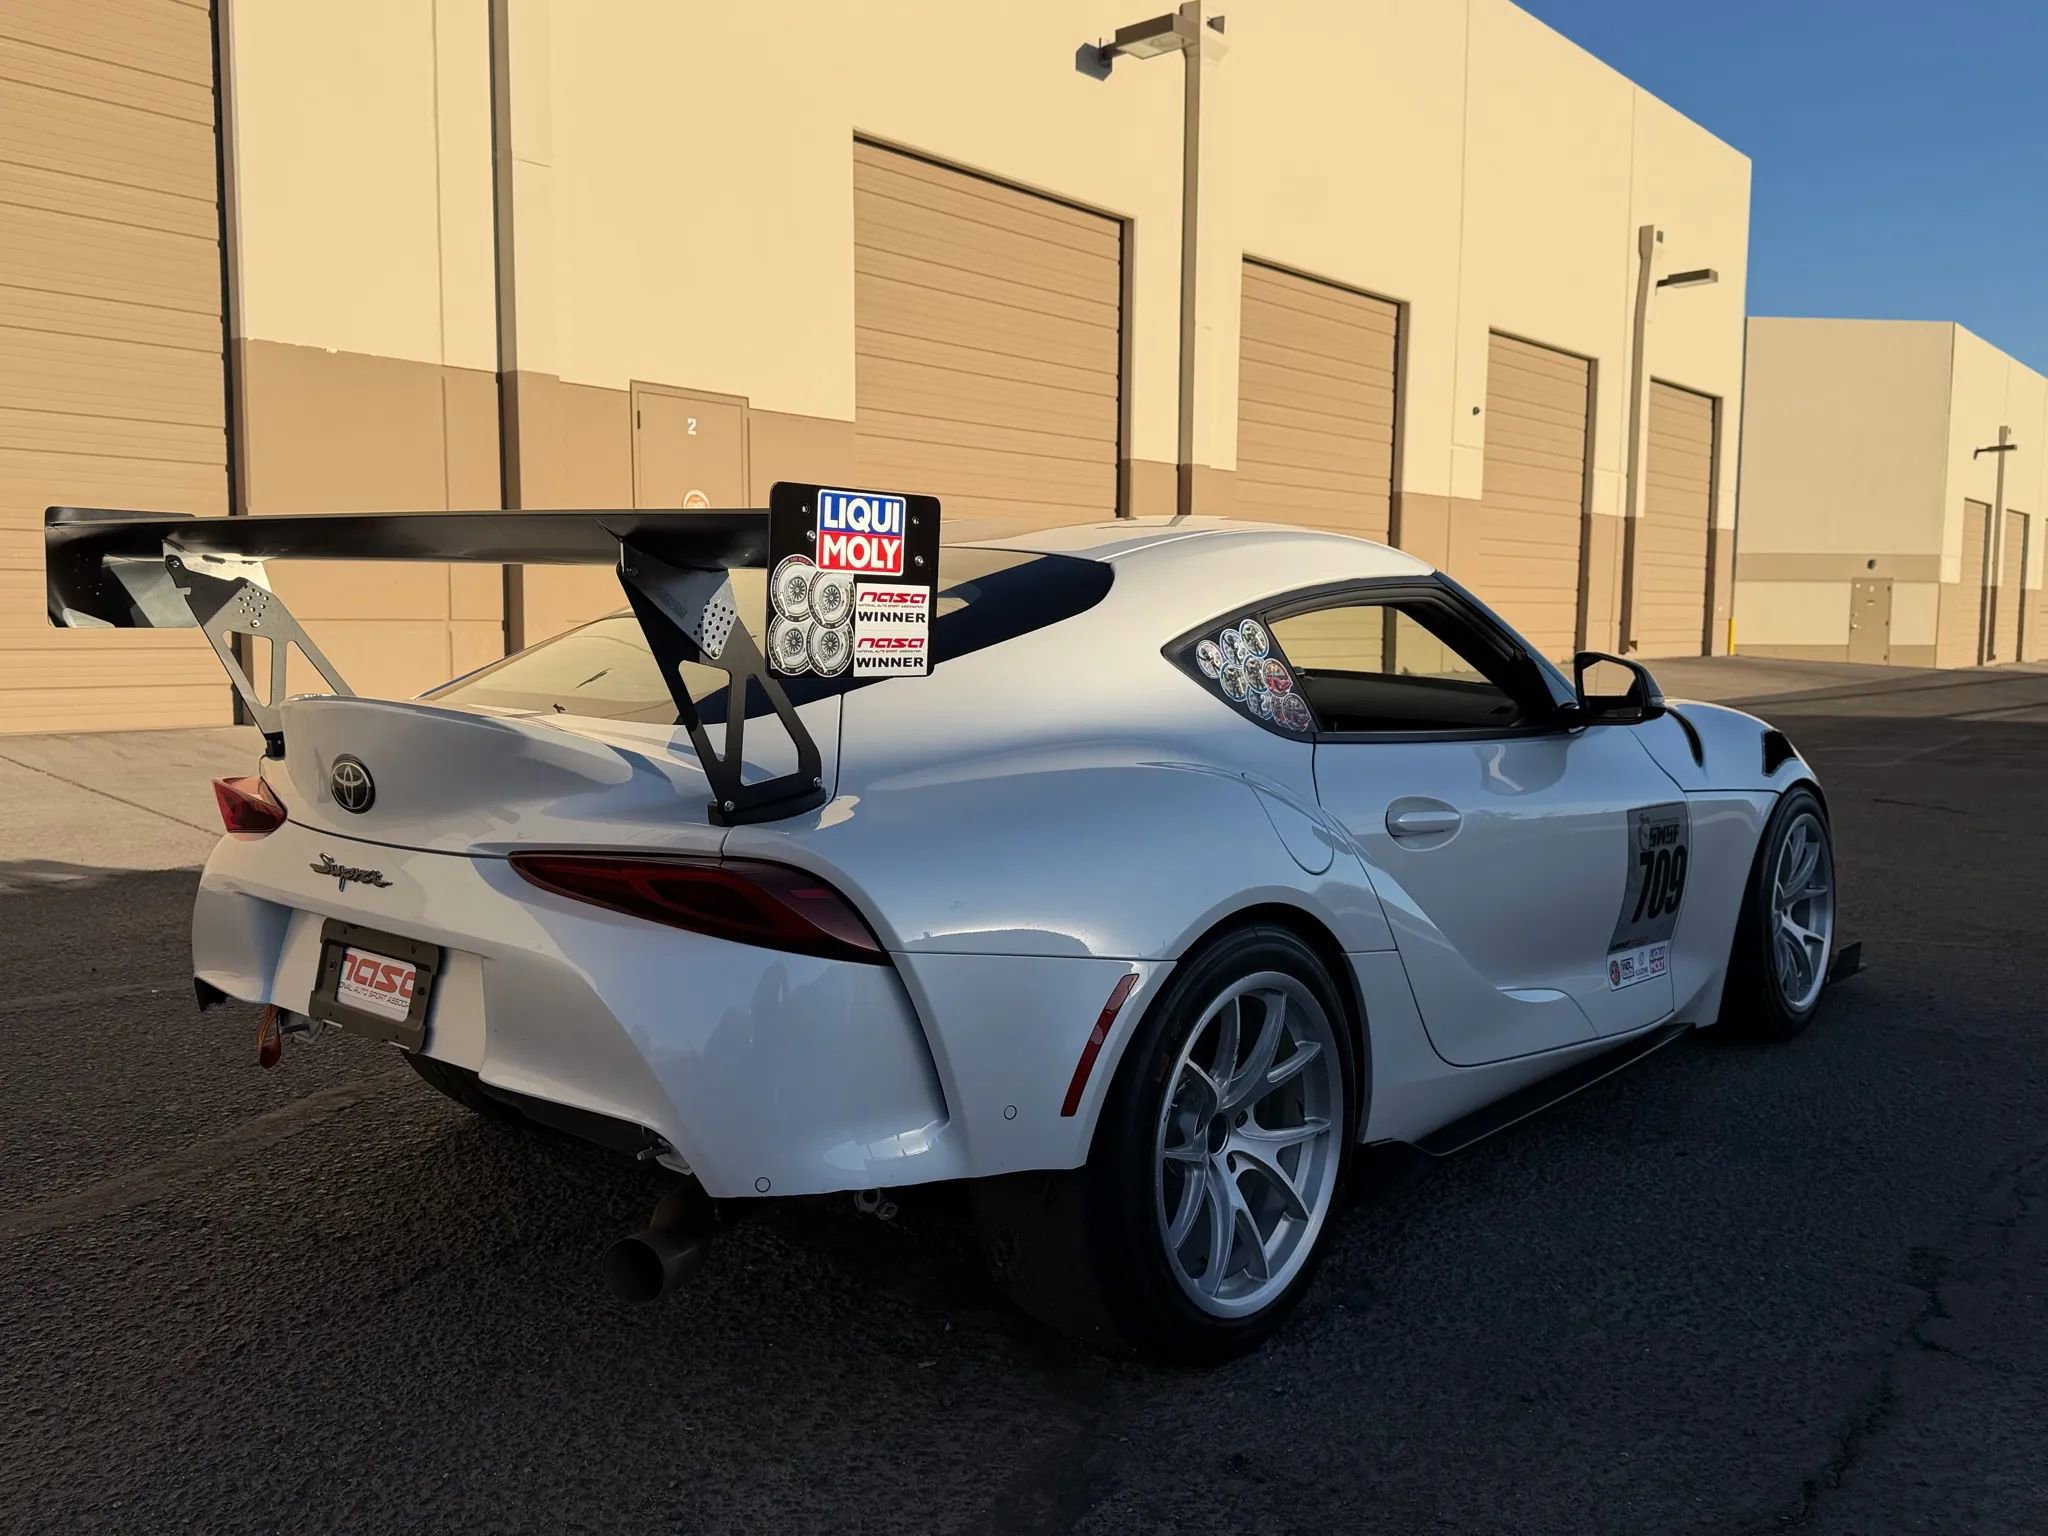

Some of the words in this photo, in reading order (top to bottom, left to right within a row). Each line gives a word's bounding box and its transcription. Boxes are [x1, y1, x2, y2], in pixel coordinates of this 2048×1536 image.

[688, 418, 697, 435] 2
[823, 496, 900, 533] LIQUI
[822, 534, 901, 570] MOLY
[859, 591, 927, 603] nasa
[858, 611, 926, 623] WINNER
[857, 638, 925, 649] nasa
[856, 657, 924, 668] WINNER
[310, 852, 393, 892] Supra
[1632, 845, 1687, 923] 709
[353, 986, 369, 996] AUTO
[368, 990, 388, 1001] SPORT
